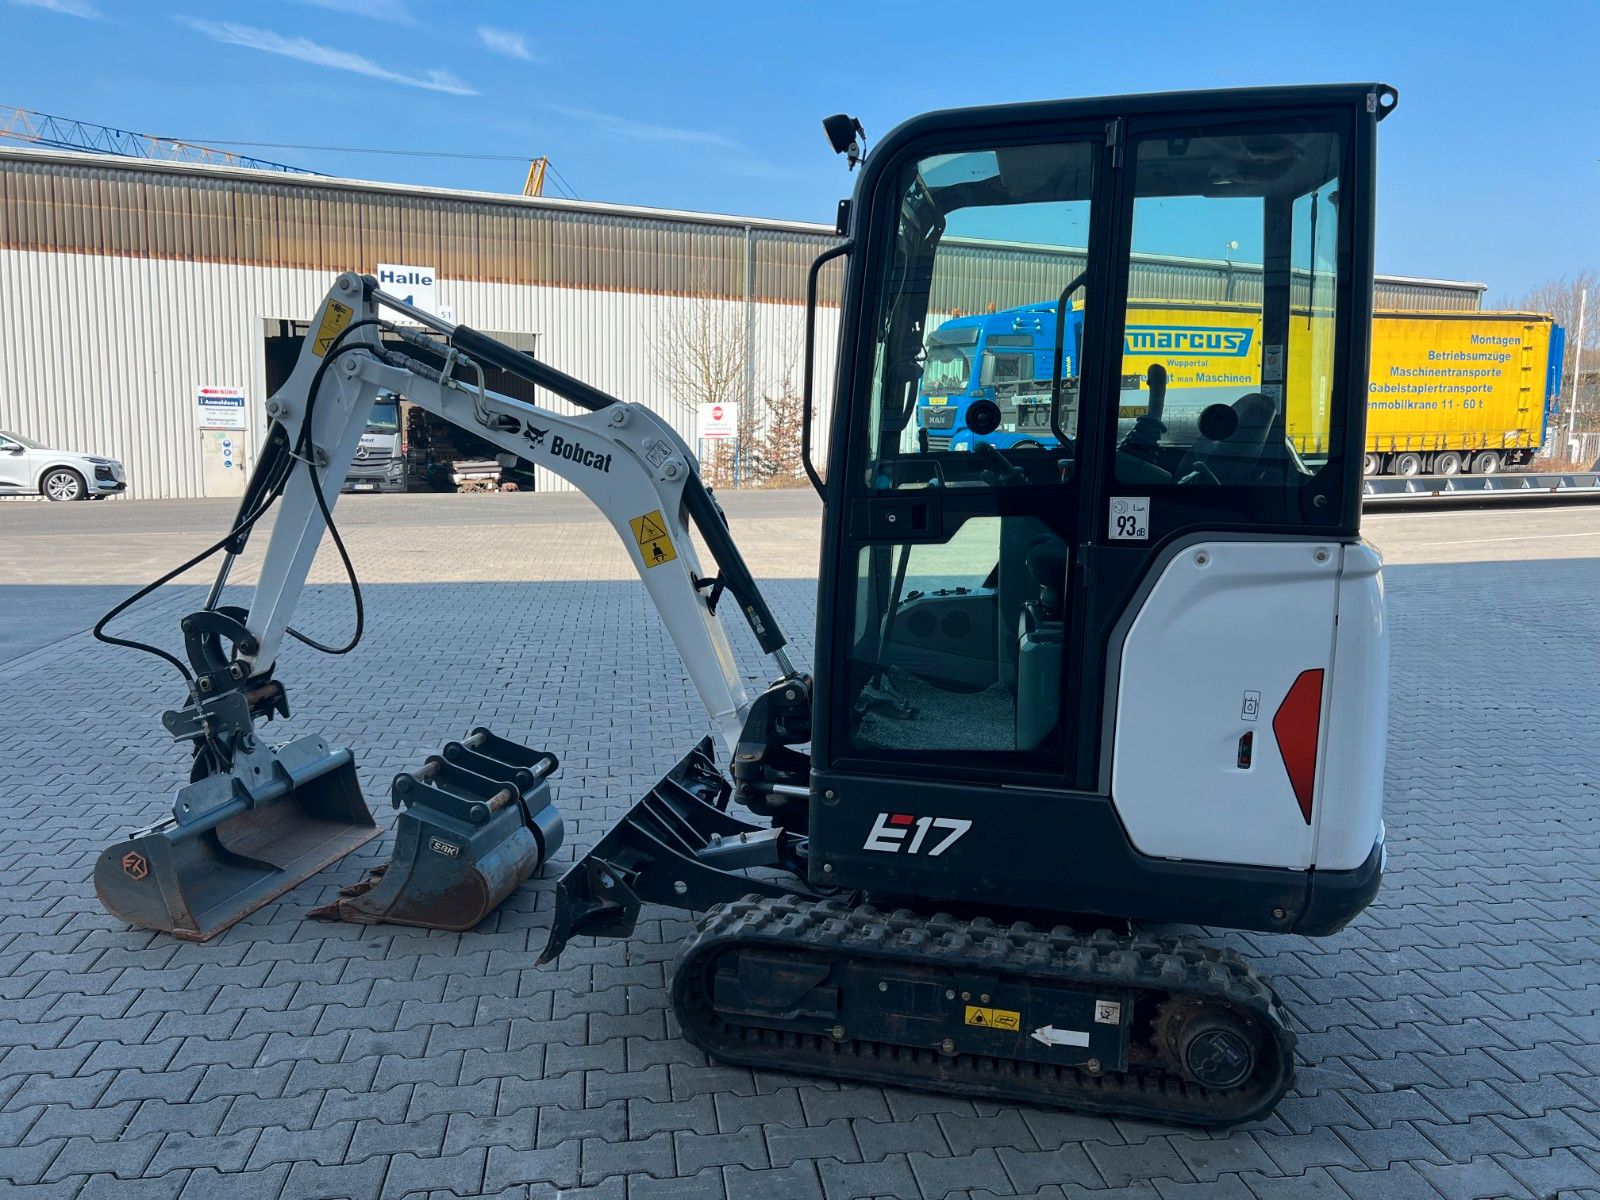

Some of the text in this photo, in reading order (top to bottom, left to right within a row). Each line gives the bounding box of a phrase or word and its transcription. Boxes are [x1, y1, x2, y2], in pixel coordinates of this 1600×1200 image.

[380, 271, 433, 286] Halle
[1126, 333, 1243, 349] marcus
[1471, 334, 1521, 347] Montagen
[1428, 350, 1511, 363] Betriebsumzüge
[1167, 360, 1208, 368] Wuppertal
[1196, 373, 1251, 383] Maschinen
[1390, 366, 1502, 379] Maschinentransporte
[1368, 382, 1493, 396] Gabelstaplertransporte
[1441, 399, 1454, 409] 11
[1463, 399, 1476, 409] 60
[1479, 399, 1483, 408] t
[551, 435, 612, 473] Bobcat
[1117, 516, 1136, 537] 93
[863, 813, 972, 856] E17
